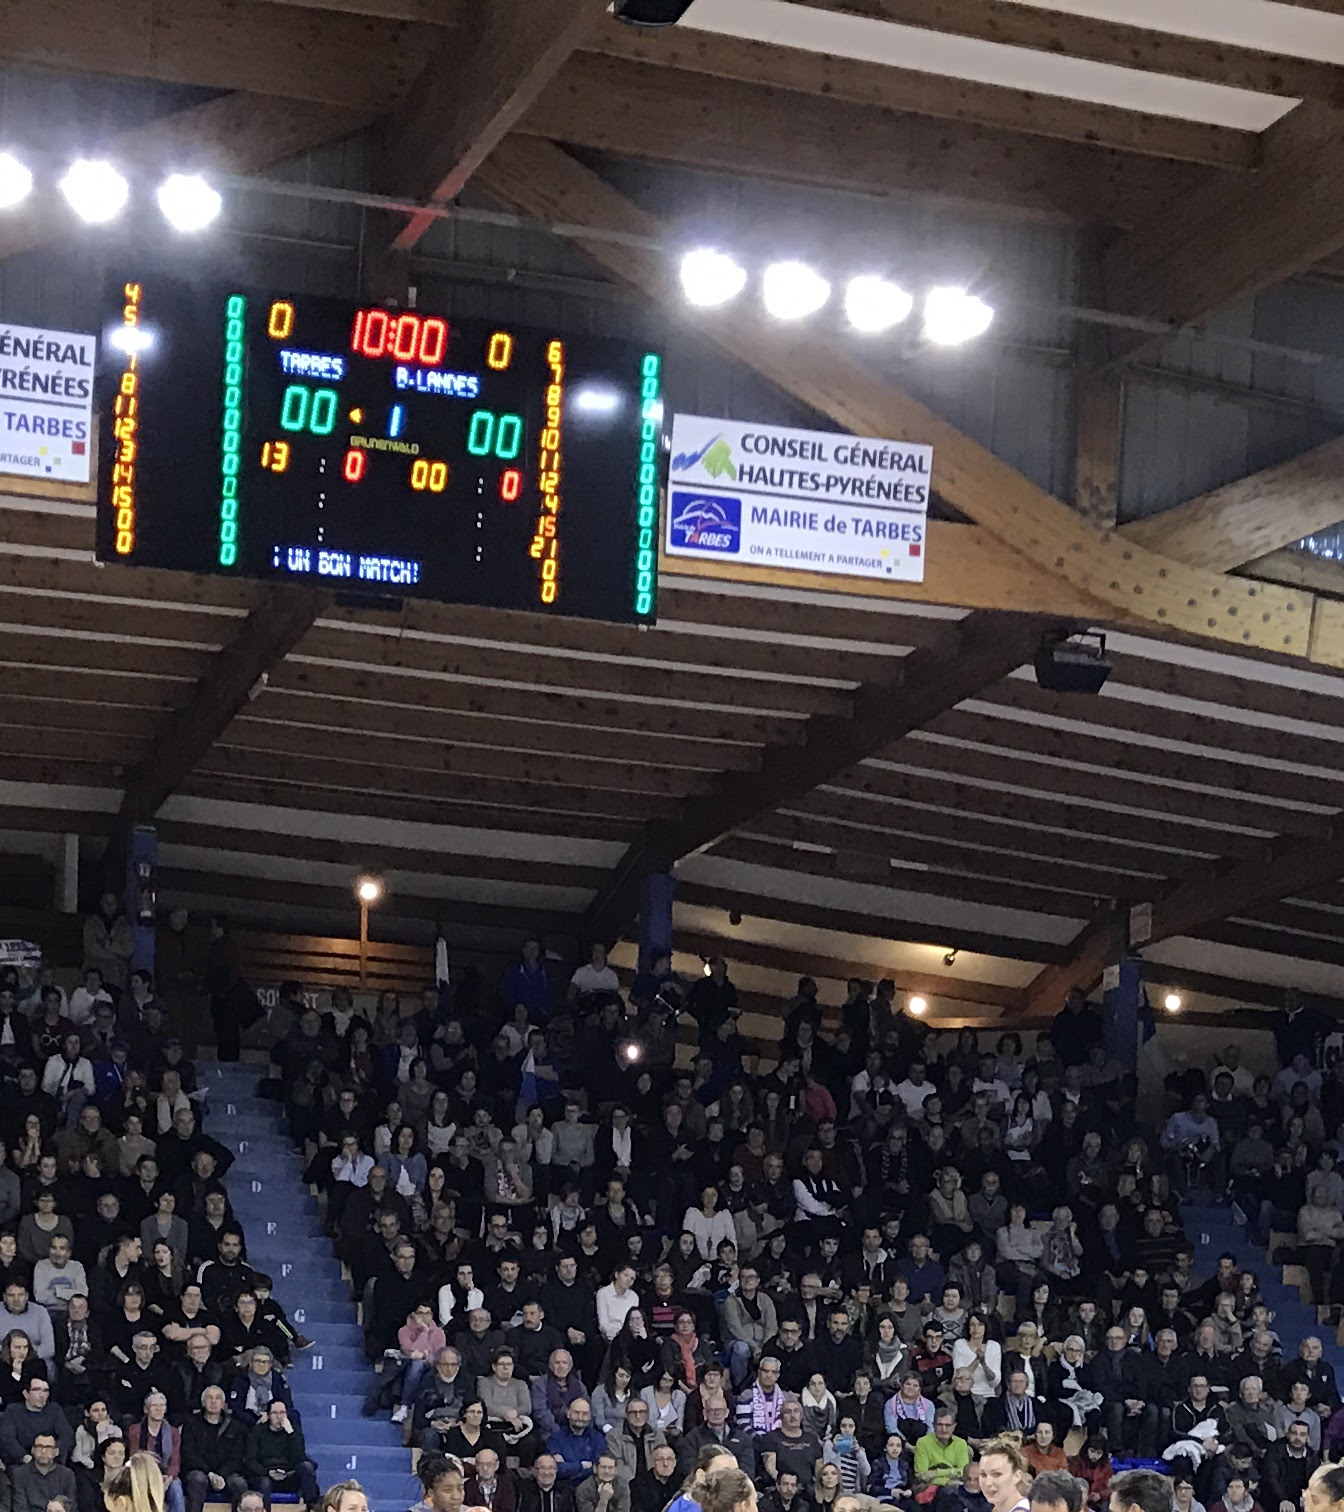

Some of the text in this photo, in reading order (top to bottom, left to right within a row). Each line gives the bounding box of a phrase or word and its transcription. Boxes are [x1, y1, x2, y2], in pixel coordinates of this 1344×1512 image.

[268, 302, 293, 339] 0
[352, 310, 447, 364] 10:00
[488, 333, 512, 369] 0
[121, 372, 136, 395] 8
[547, 385, 561, 406] 8
[115, 395, 136, 417] 11
[280, 385, 338, 435] 00
[4, 411, 87, 440] TARBES
[114, 417, 135, 440] 12
[389, 406, 400, 437] 1
[467, 411, 522, 459] 00
[541, 429, 560, 450] 10
[260, 441, 290, 472] 13
[345, 450, 364, 481] 0
[540, 450, 560, 471] 11
[740, 433, 929, 475] CONSEIL GÉNÉRAL
[113, 463, 133, 484] 14
[411, 460, 447, 492] 00
[501, 470, 520, 501] 0
[540, 472, 558, 493] 12
[738, 463, 926, 503] HAUTES-PYRÉNÉES
[112, 486, 132, 508] 15
[539, 516, 557, 537] 15
[750, 506, 922, 543] MAIRIE de TARBES
[684, 530, 732, 548] TARBES
[318, 551, 351, 577] BON
[749, 545, 763, 555] ON
[774, 548, 825, 562] TELLEMENT
[836, 555, 883, 570] PARTAGER
[294, 1308, 306, 1323] G
[312, 1355, 323, 1370] H
[330, 1404, 337, 1419] I
[346, 1455, 356, 1470] J
